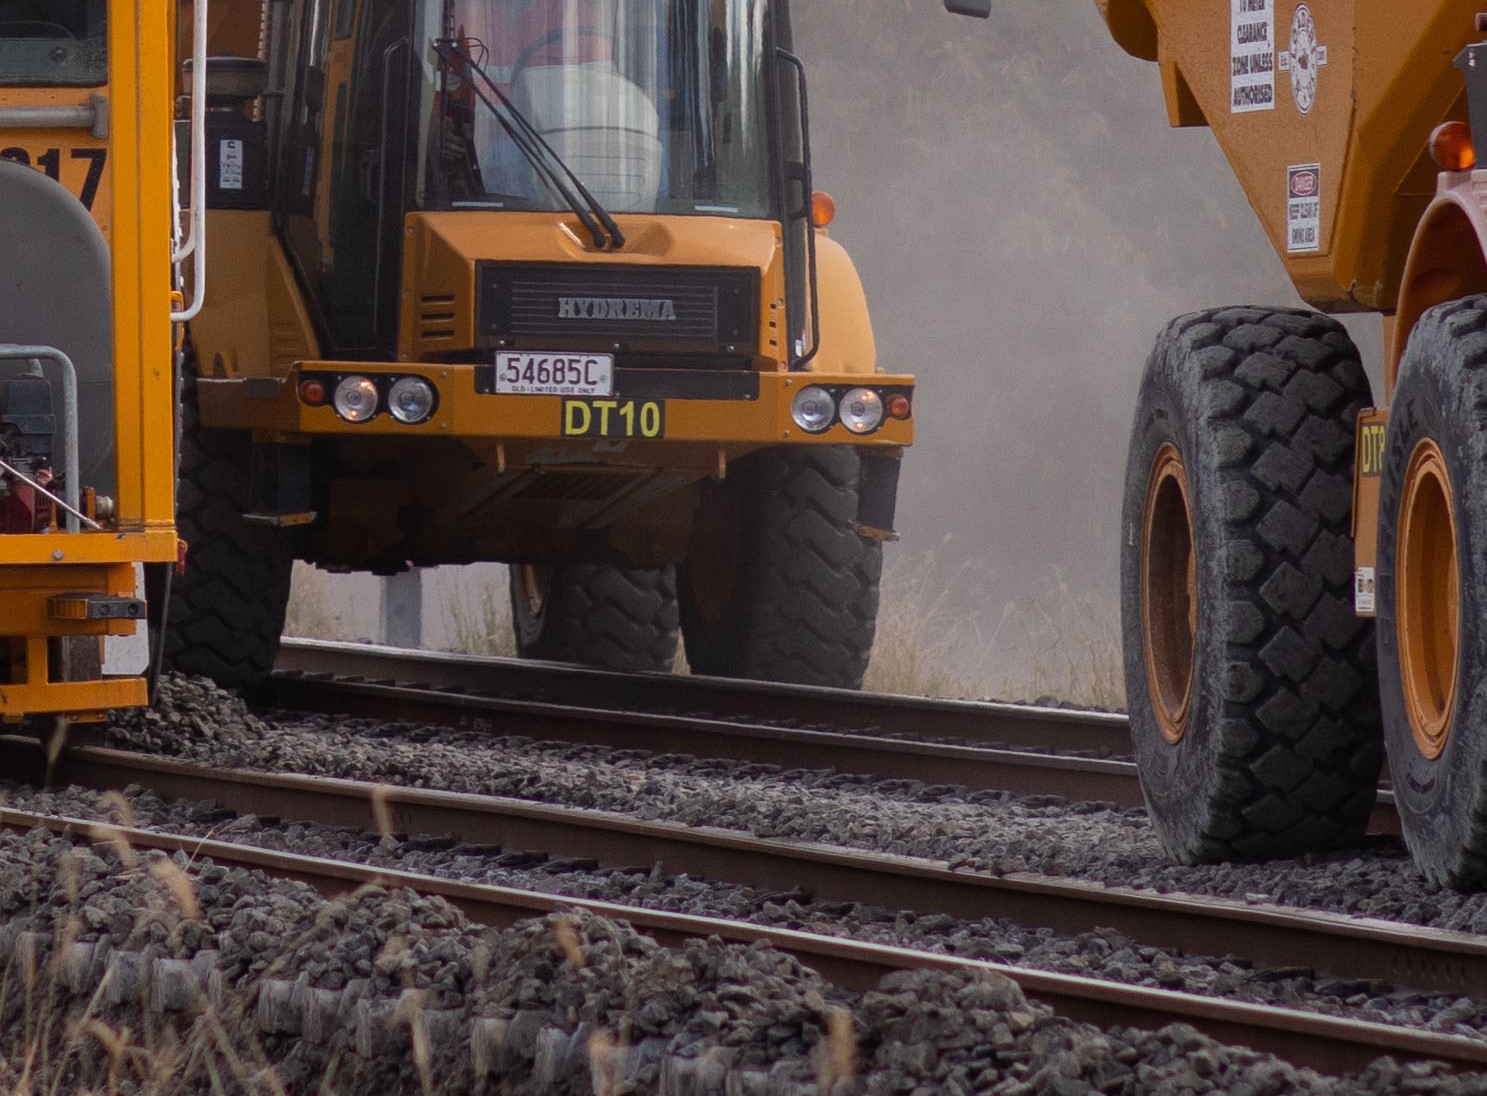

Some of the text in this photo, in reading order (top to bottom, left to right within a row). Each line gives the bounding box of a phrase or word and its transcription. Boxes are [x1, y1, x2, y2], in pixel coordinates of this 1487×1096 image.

[1237, 21, 1267, 44] CLEARANCE
[1232, 55, 1249, 76] ZONE
[1250, 52, 1273, 74] UNLESS
[558, 297, 676, 321] HYDREMA
[506, 357, 598, 385] 54685C
[565, 400, 660, 437] DT10
